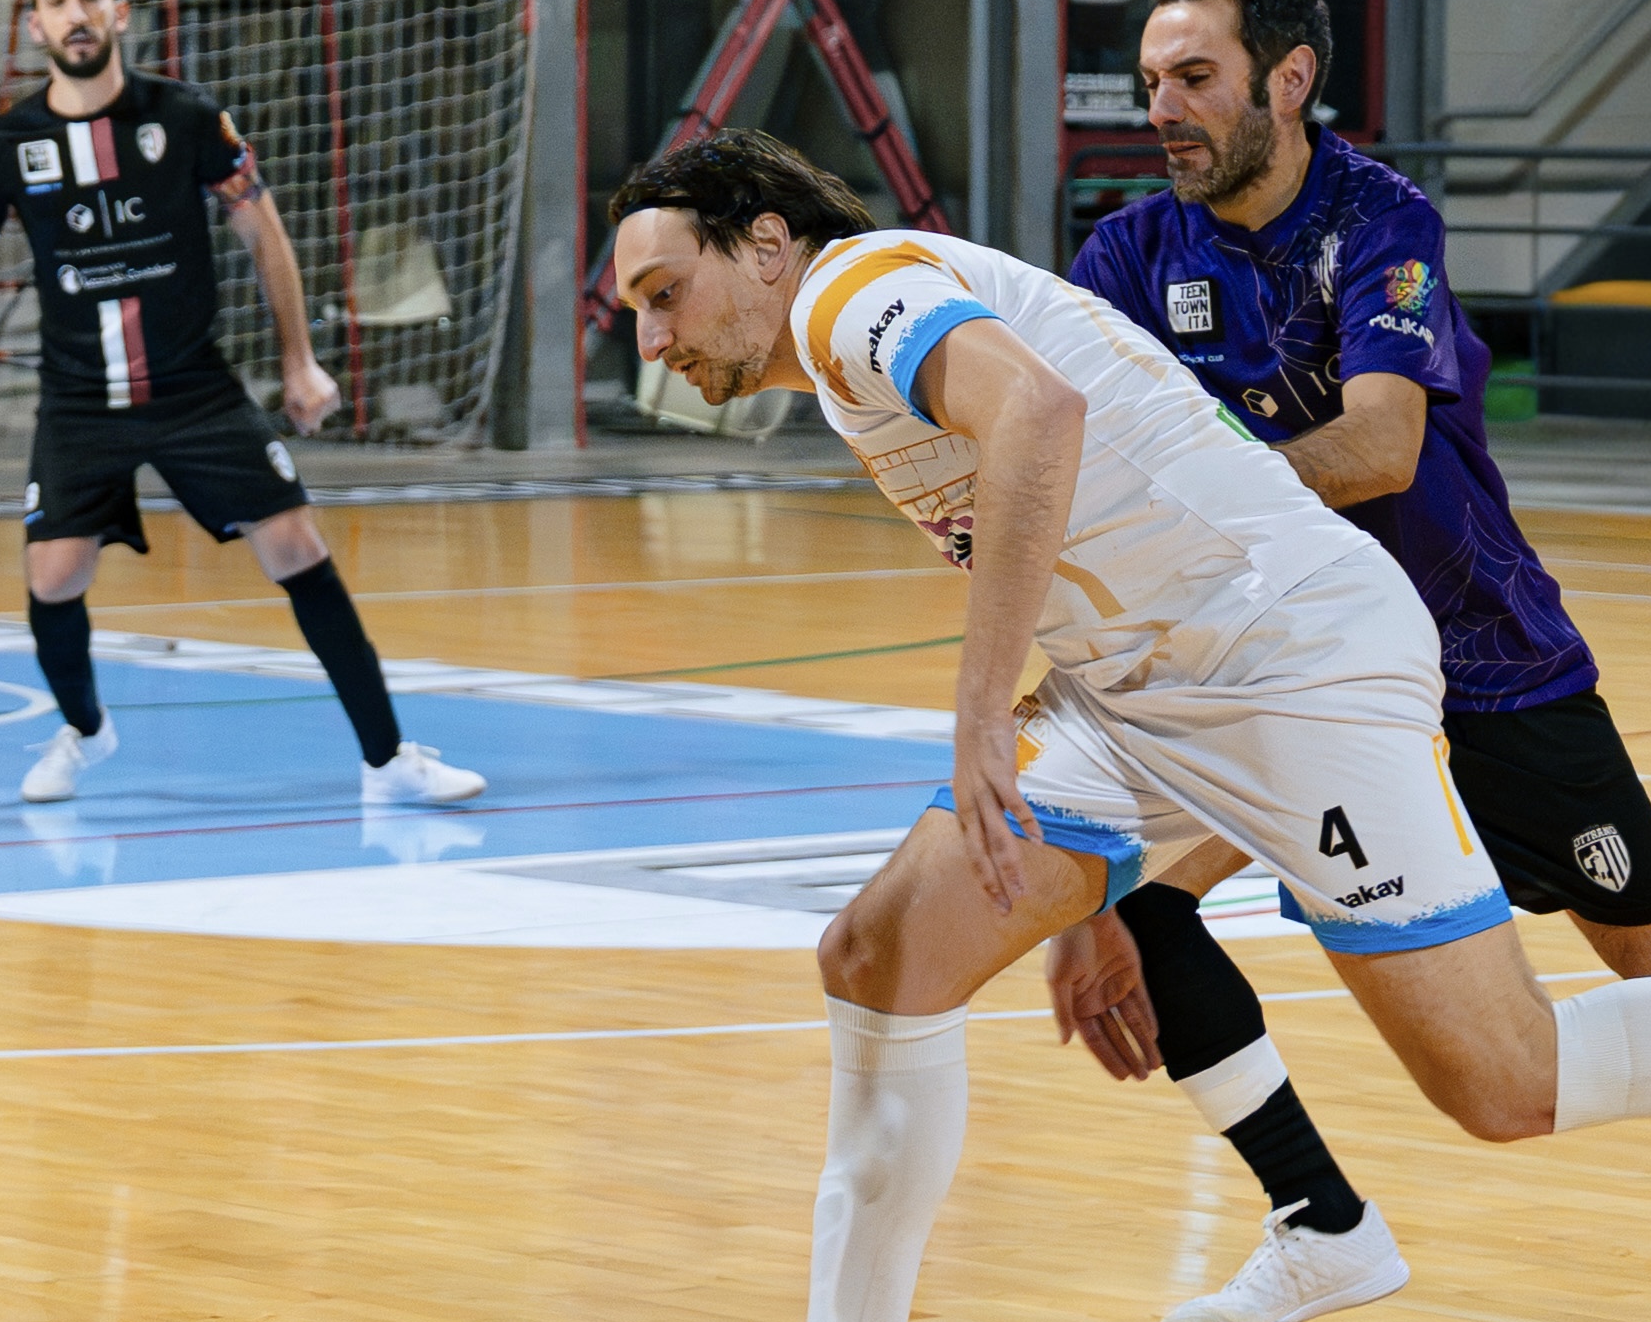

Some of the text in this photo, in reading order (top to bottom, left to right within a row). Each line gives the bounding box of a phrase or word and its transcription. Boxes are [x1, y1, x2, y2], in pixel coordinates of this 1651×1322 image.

[1180, 284, 1207, 299] TEEN
[1173, 299, 1209, 315] TOWN
[1188, 314, 1209, 330] ITA
[869, 297, 906, 374] makay
[1318, 805, 1369, 870] 4
